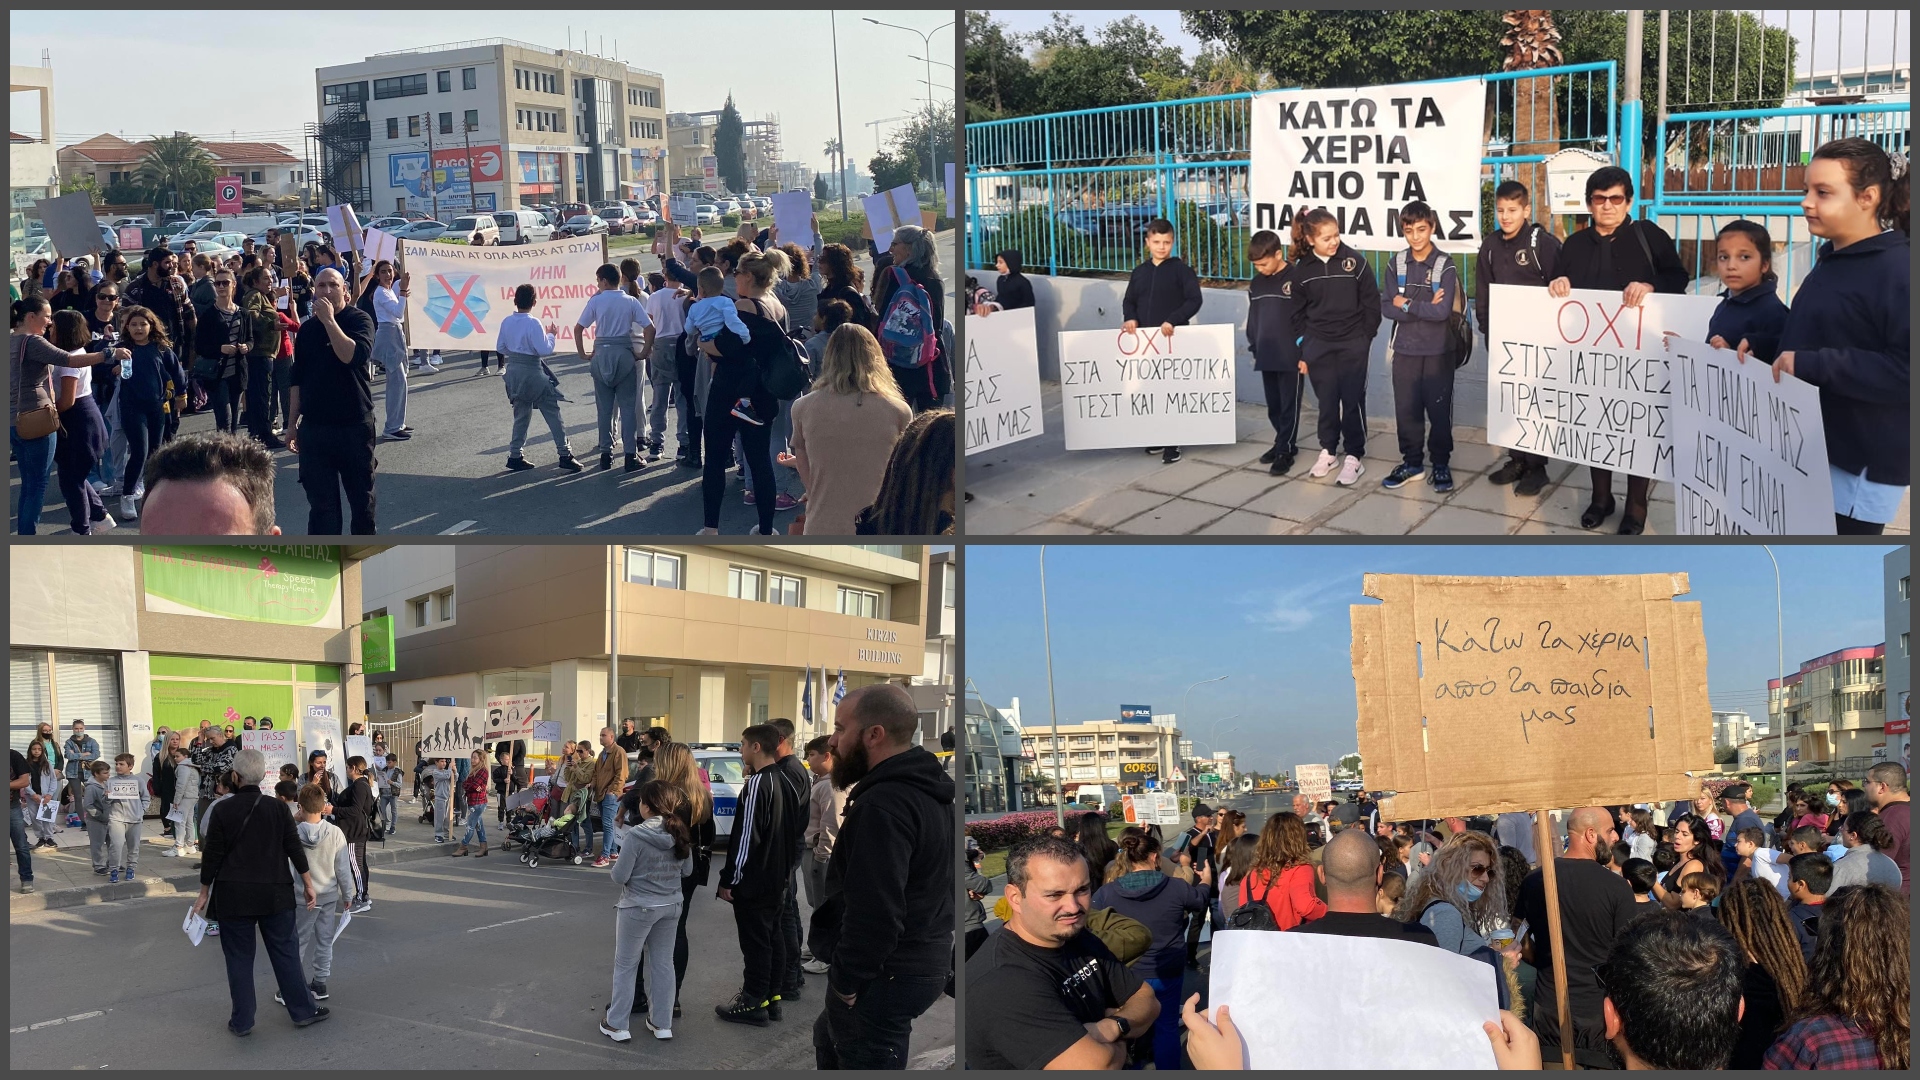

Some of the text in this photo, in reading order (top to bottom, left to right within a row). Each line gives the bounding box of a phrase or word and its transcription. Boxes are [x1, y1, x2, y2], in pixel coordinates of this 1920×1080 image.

[1279, 97, 1445, 129] ΚΑΤΩ ΤΑ
[1300, 134, 1411, 164] ΧΕΡΙΑ
[226, 188, 233, 198] P
[1288, 170, 1427, 201] ΑΠΟ ΤΑ
[1256, 203, 1374, 235] ΠΑΙΑ
[1557, 299, 1645, 351] ΟΧΙ
[1064, 358, 1231, 385] ΣΤΑ ΥΠΟΧΡΕΩΤΙΚΑ
[1498, 341, 1672, 395] ΣΤΙΣ ΙΑΤΡΙΚΕΣ
[1073, 391, 1232, 418] ΤΕΣΤ ΚΑΙ ΜΑΣΚΕΣ
[1499, 381, 1669, 438] ΠΡΑΞΕΙΣ ΧΩΡΙΣ
[1677, 354, 1808, 477] ΤΑ ΠΑΙΔΙΑ ΜΑΣ
[997, 405, 1032, 441] ΜΑΣ
[1514, 417, 1635, 470] ΣΥΝΑΙΝΕΣΗ
[1695, 431, 1786, 535] ΔΕΝ ΕΙΝΑΙ
[181, 552, 197, 567] 25
[201, 554, 249, 575] 568279
[263, 580, 315, 594] Therapy Centre
[283, 572, 316, 587] Speech
[866, 627, 897, 643] KIRZIS
[1435, 616, 1641, 660] Κάτω τα χέρια
[858, 648, 902, 665] BUILDING
[1435, 666, 1632, 699] από τα παιδιά
[243, 732, 286, 741] NO PASS
[1520, 705, 1577, 744] μας
[1124, 763, 1157, 773] CORSO
[1299, 778, 1329, 787] ΕΝΑΝΤΙΑ
